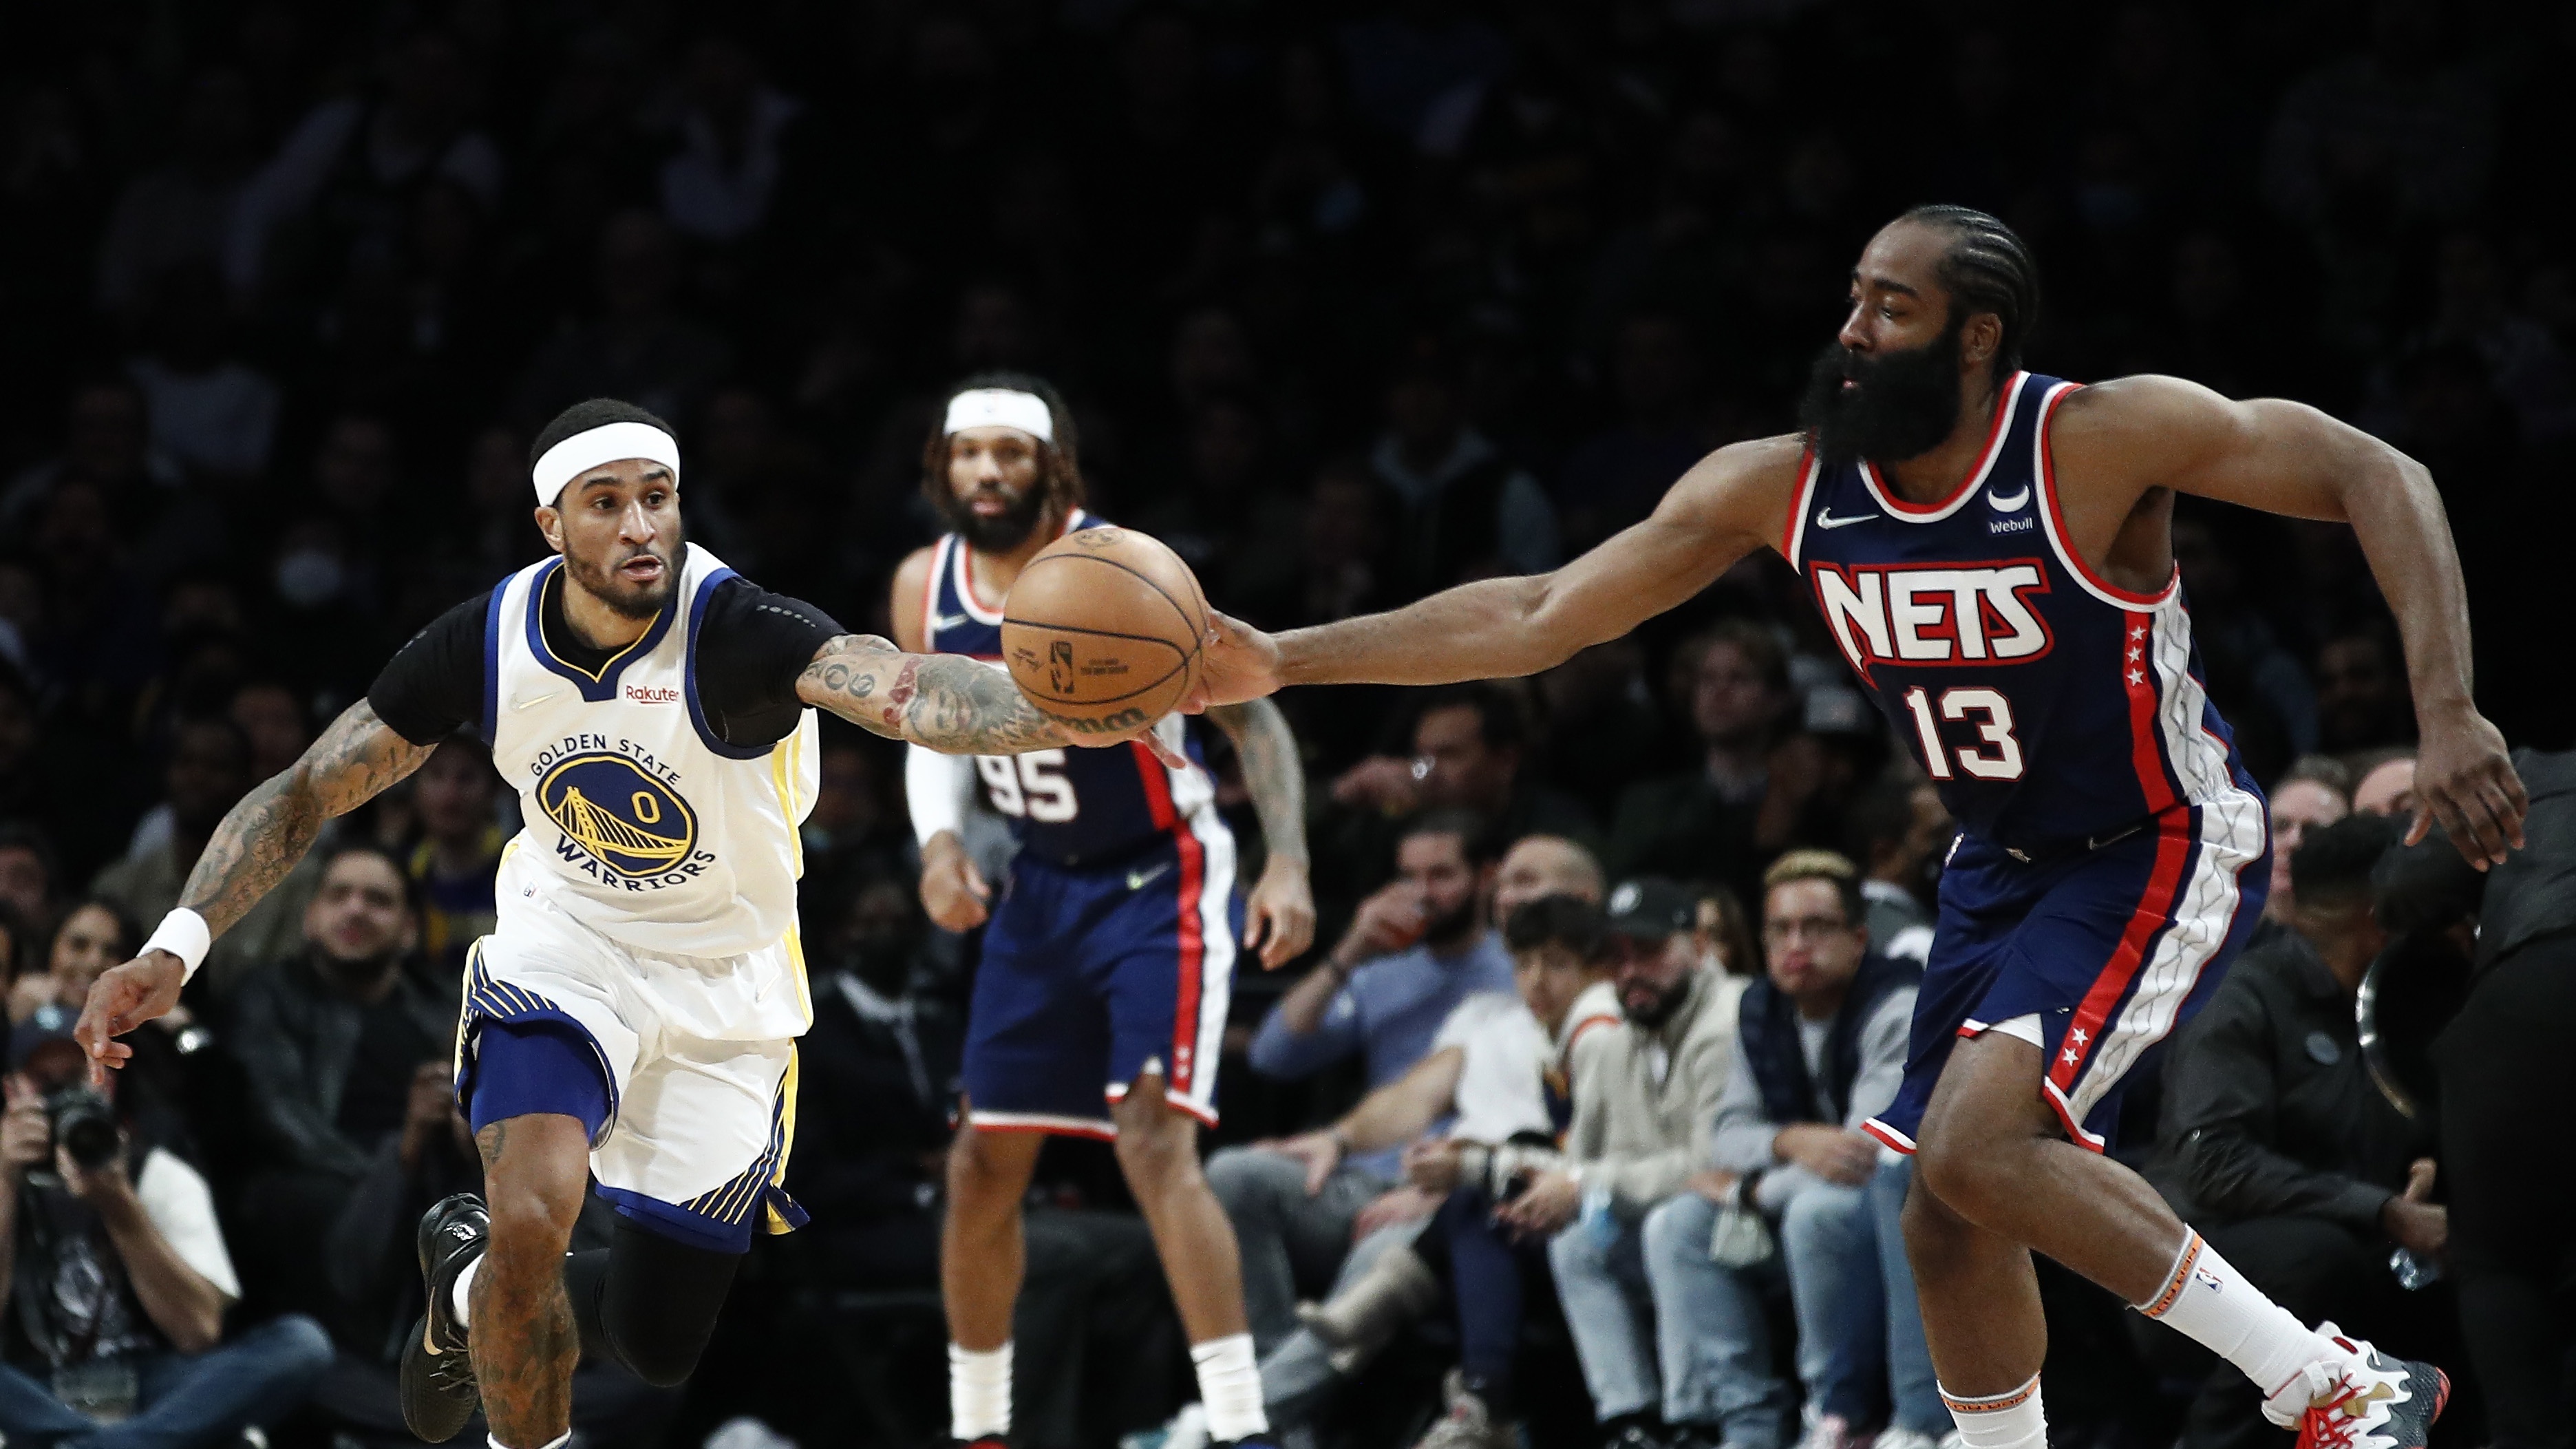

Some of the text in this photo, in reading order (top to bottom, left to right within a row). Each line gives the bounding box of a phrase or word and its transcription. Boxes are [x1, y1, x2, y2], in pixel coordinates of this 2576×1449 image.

[1990, 518, 2034, 534] Webull
[1811, 558, 2054, 685] NETS
[531, 733, 681, 785] GOLDEN STATE
[1903, 685, 2025, 781] 13
[630, 790, 661, 824] 0
[976, 749, 1078, 822] 95
[555, 834, 716, 892] WARRIORS
